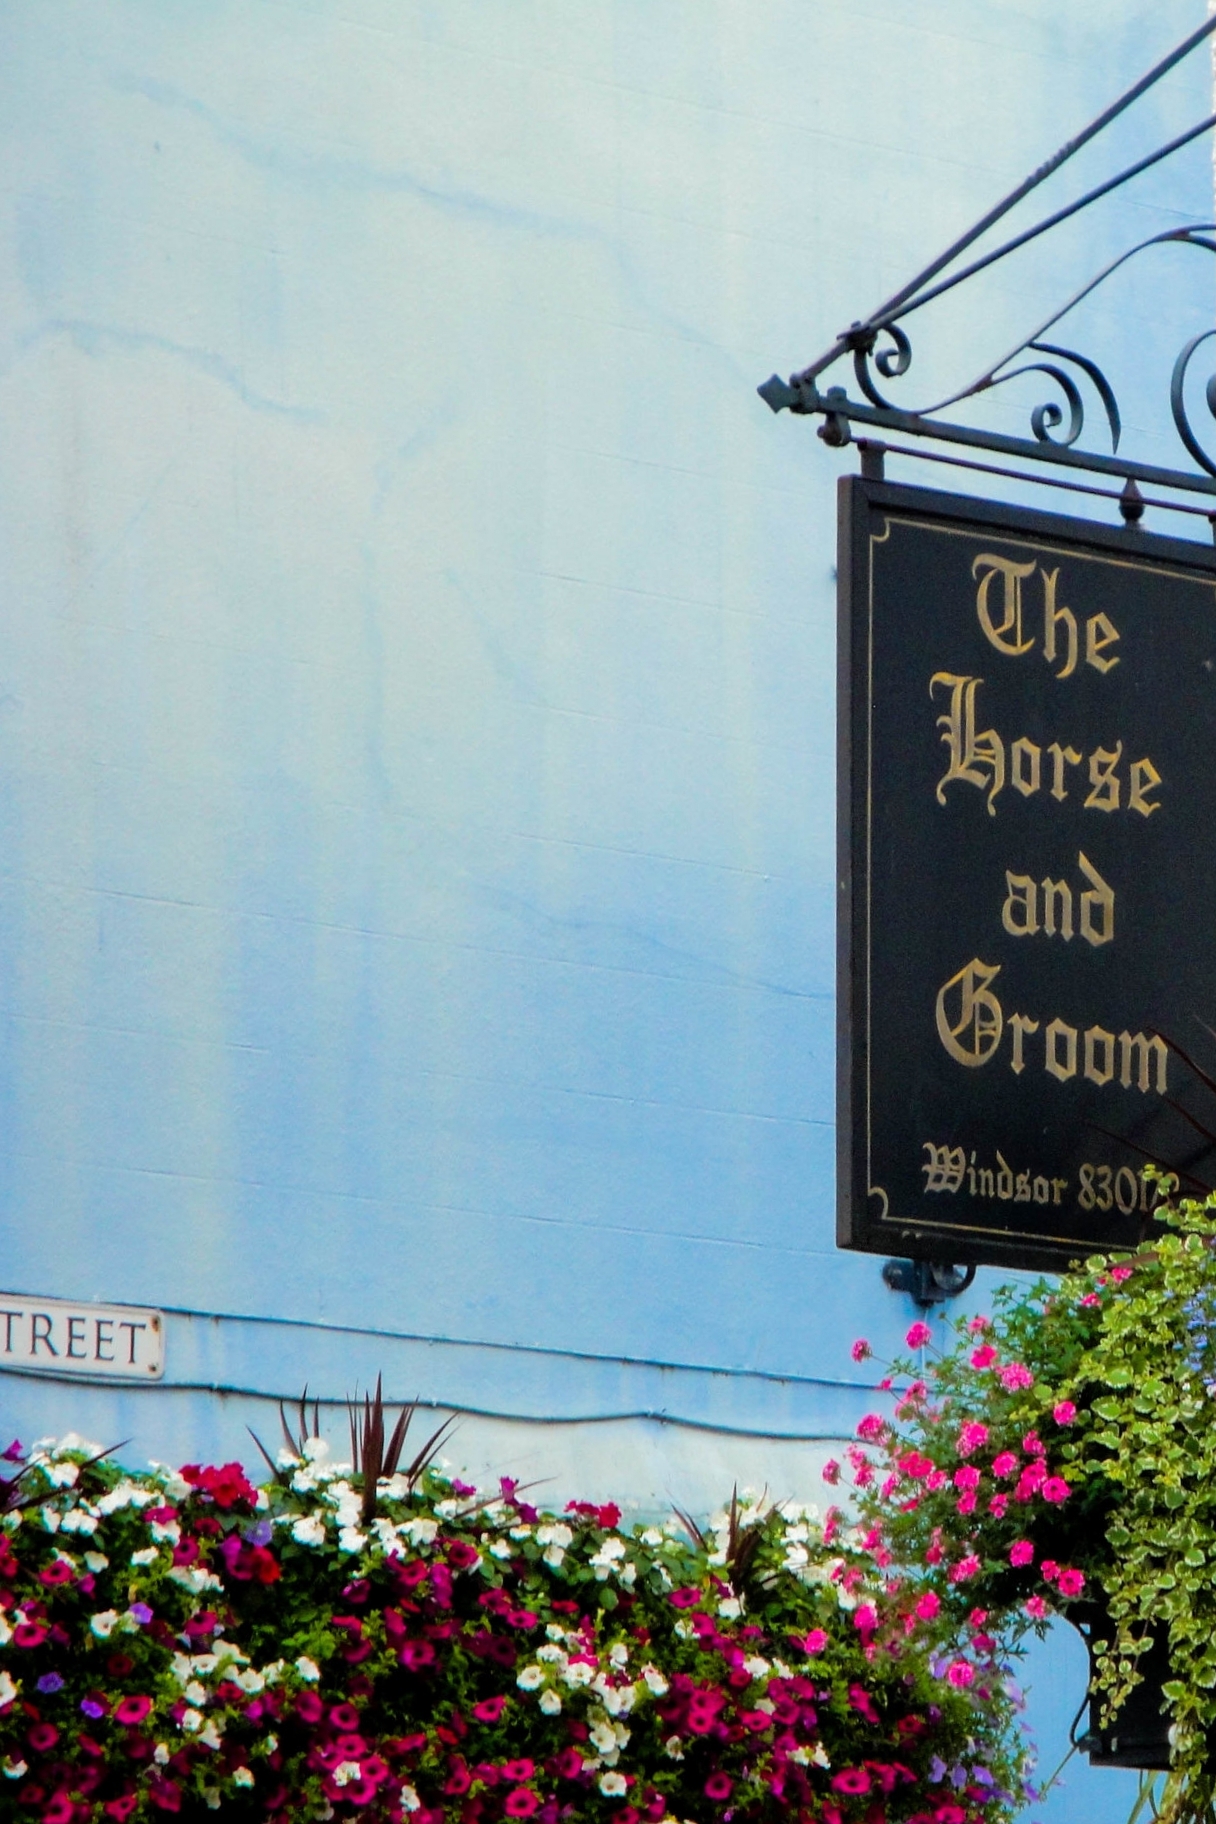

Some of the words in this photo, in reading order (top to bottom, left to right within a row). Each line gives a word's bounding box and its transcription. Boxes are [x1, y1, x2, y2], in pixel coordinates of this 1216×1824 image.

[972, 552, 1120, 676] The
[930, 672, 1162, 817] Horse
[1002, 852, 1115, 946] and
[936, 958, 1168, 1094] Groom
[922, 1142, 1068, 1206] Windsor
[1078, 1163, 1180, 1214] 83017
